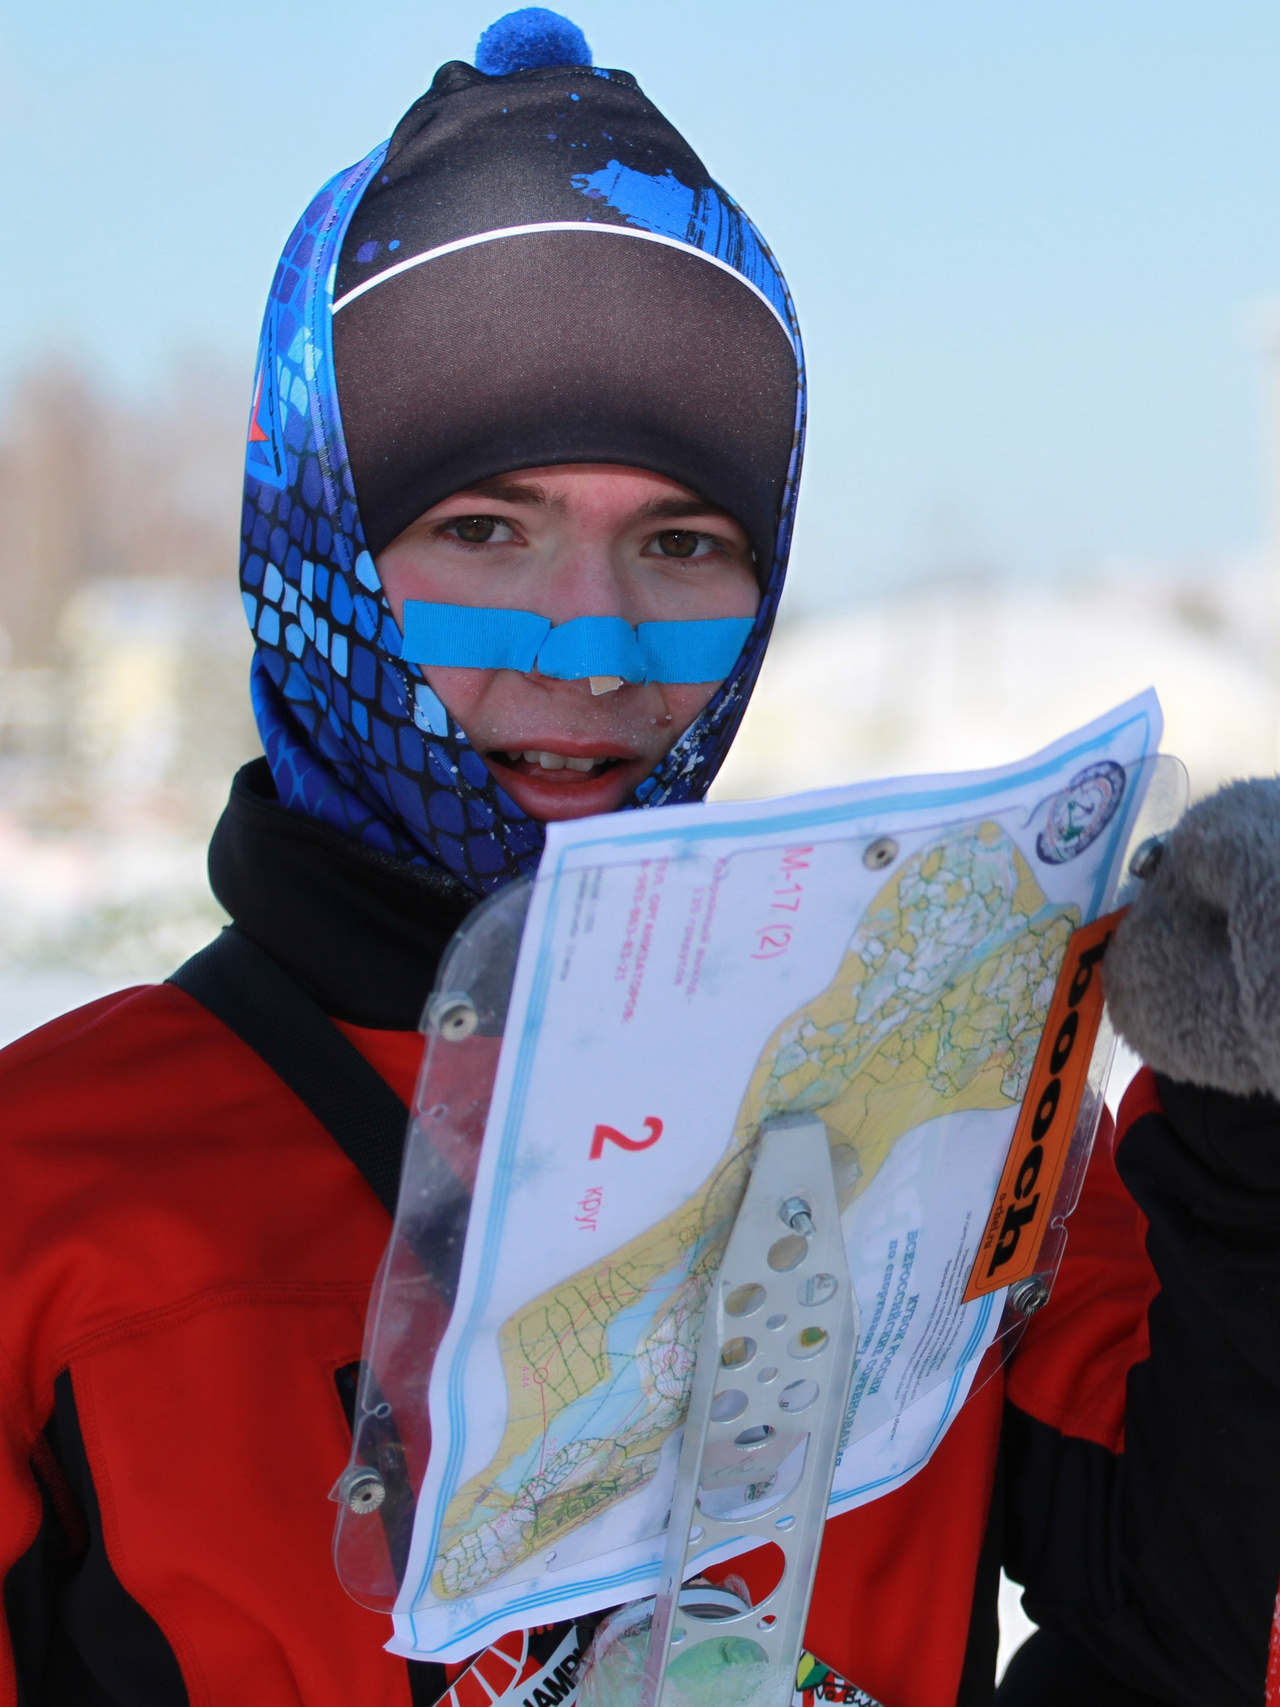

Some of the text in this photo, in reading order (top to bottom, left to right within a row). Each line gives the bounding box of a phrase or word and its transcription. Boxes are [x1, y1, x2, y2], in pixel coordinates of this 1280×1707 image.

[749, 924, 794, 960] (2)
[588, 1116, 664, 1161] 2
[986, 930, 1114, 1279] booch
[574, 1186, 604, 1233] круг
[983, 1191, 1010, 1250] o-chel.ru
[856, 1239, 898, 1355] по спортивному
[871, 1229, 919, 1357] ВСЕРОССИЙСКИЕ
[867, 1293, 920, 1396] КУБОК РОССИИ
